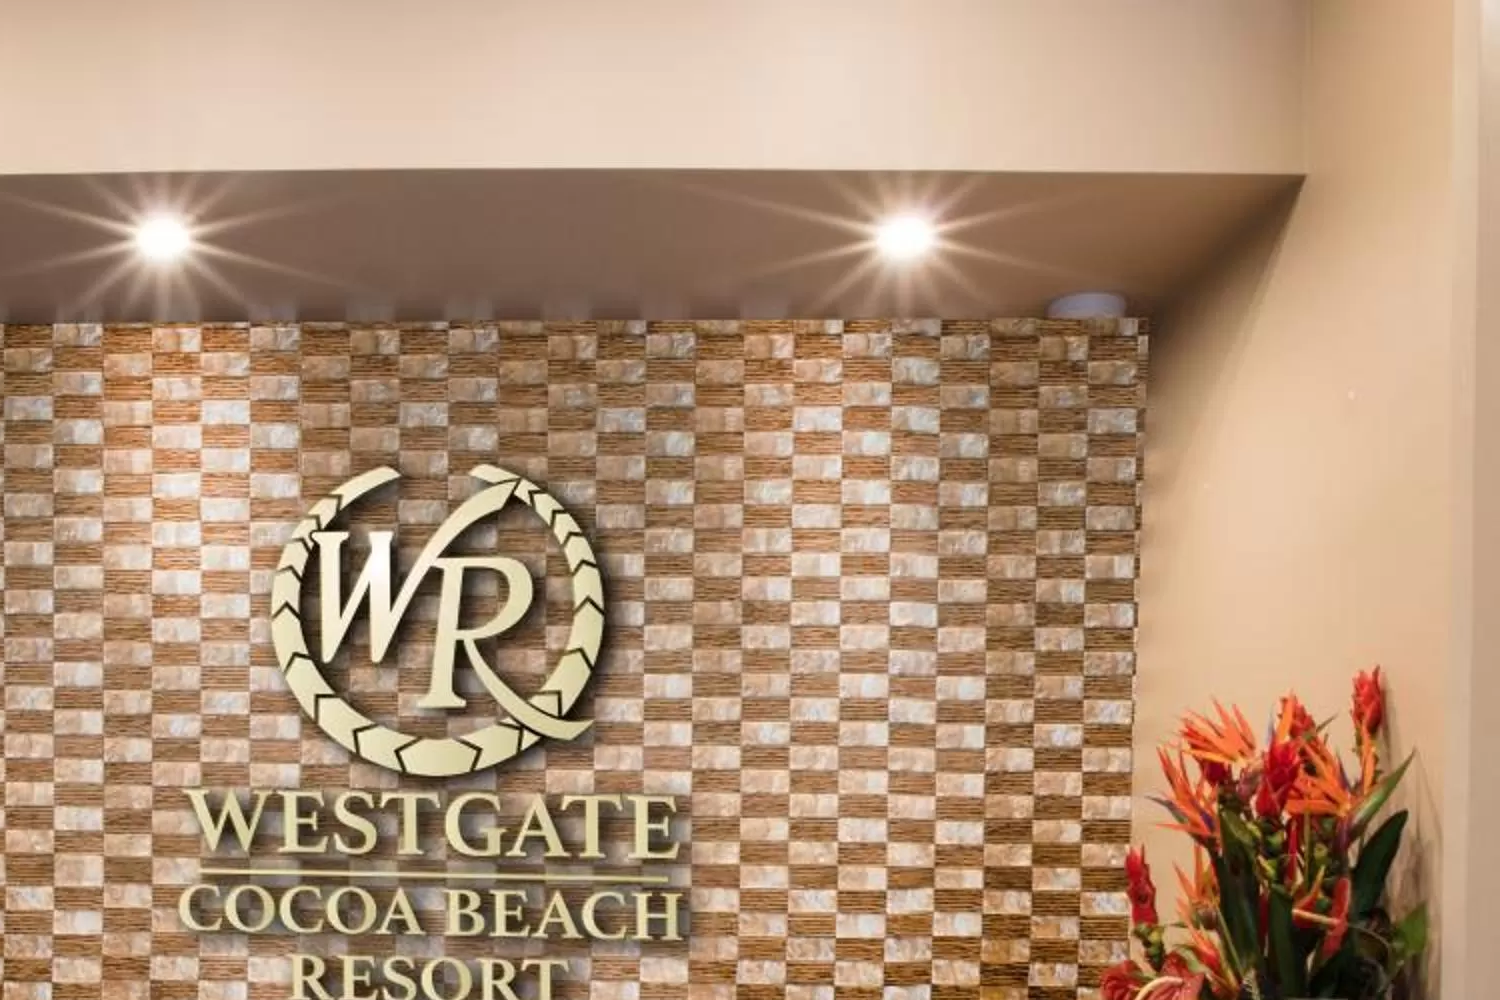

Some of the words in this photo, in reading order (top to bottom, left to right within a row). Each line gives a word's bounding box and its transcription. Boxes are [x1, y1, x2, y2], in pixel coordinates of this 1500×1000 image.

[182, 788, 681, 860] WESTGATE
[178, 883, 422, 937] COCOA
[445, 889, 683, 941] BEACH
